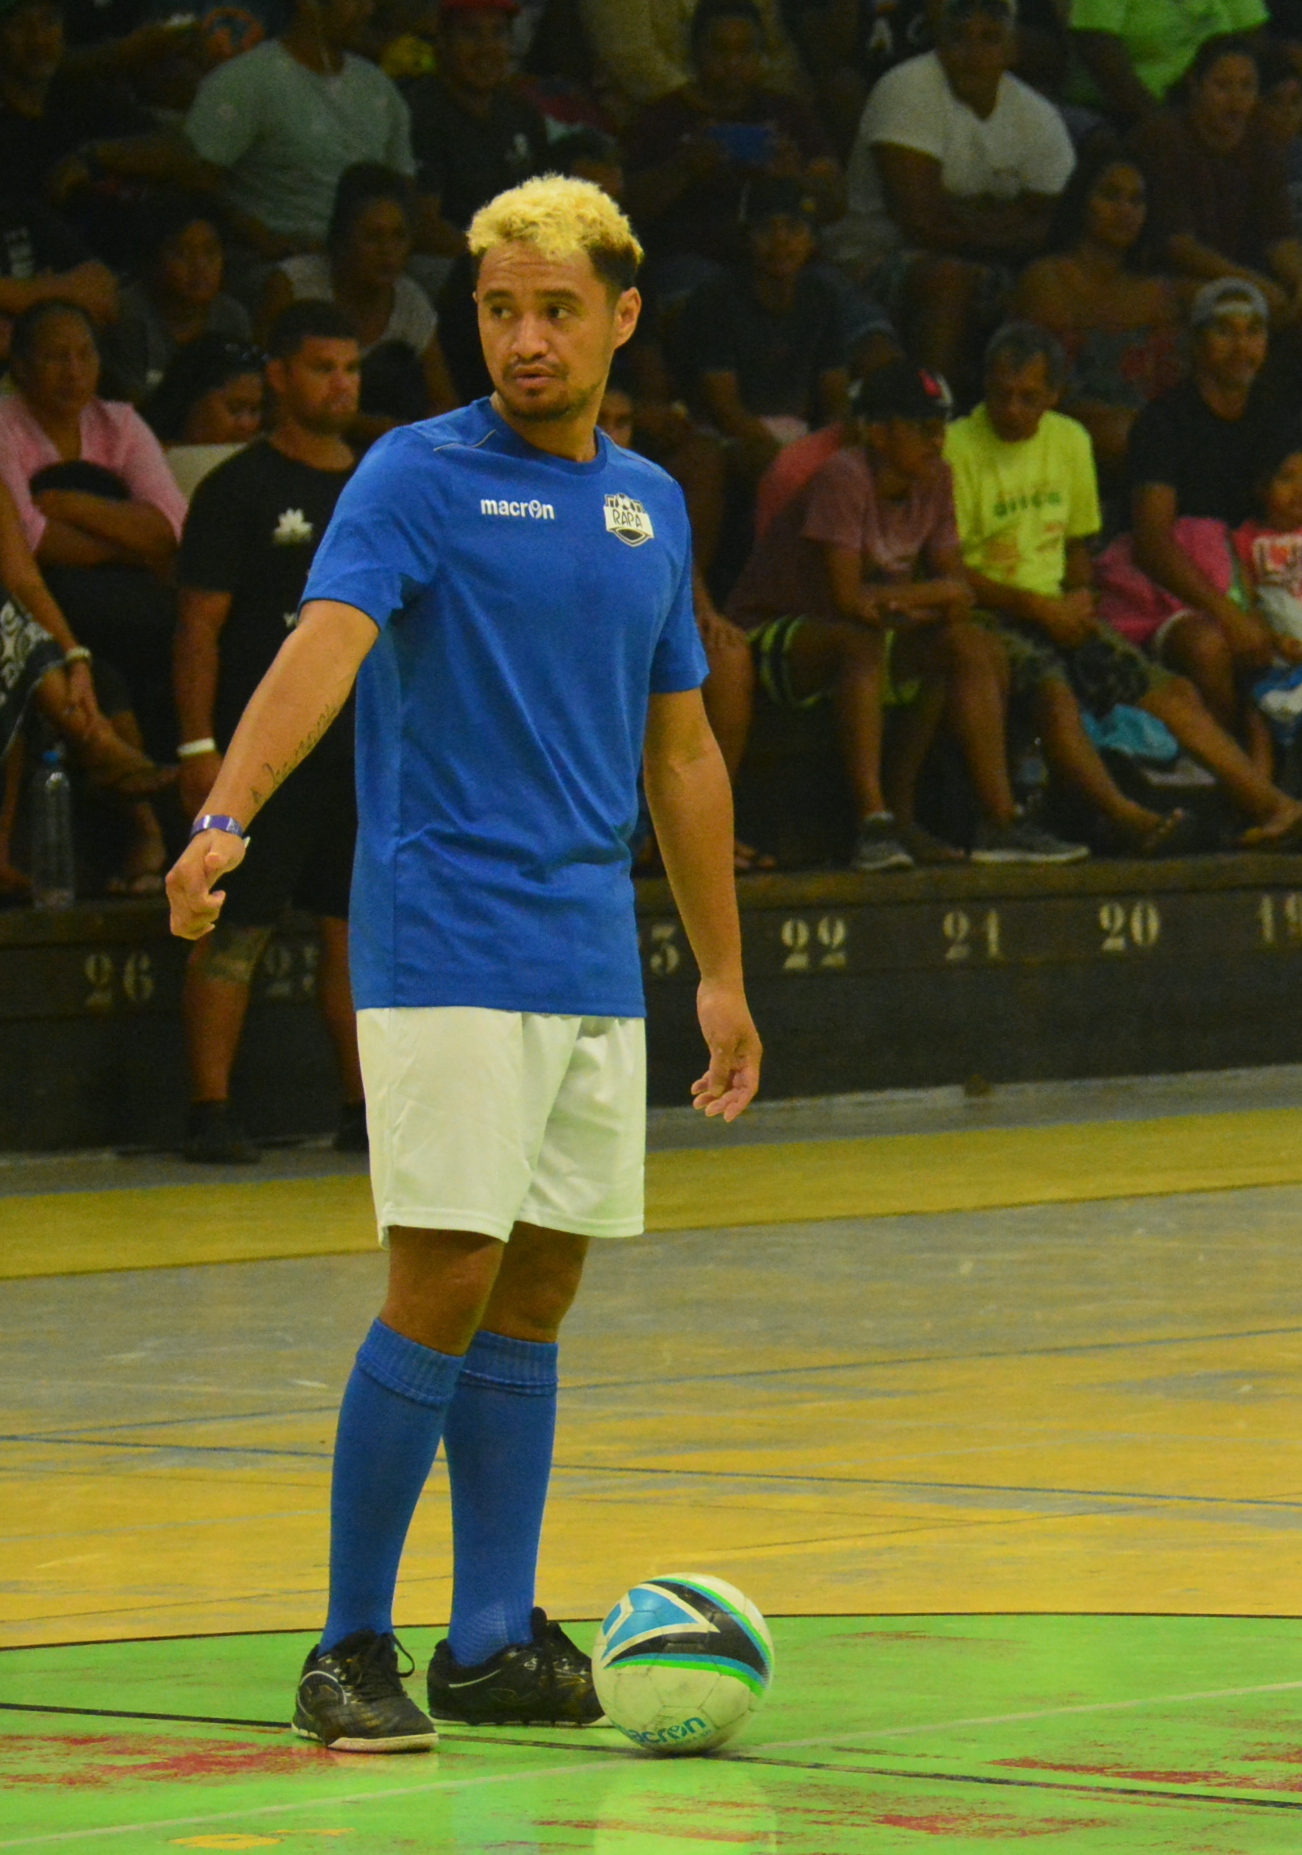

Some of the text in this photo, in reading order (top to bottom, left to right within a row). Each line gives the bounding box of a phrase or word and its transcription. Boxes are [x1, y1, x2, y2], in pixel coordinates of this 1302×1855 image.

[480, 498, 555, 520] macron
[612, 508, 643, 528] RAPA
[780, 915, 846, 971] 22
[941, 908, 1003, 961] 21
[1099, 901, 1162, 953] 20
[83, 952, 155, 1010] 26
